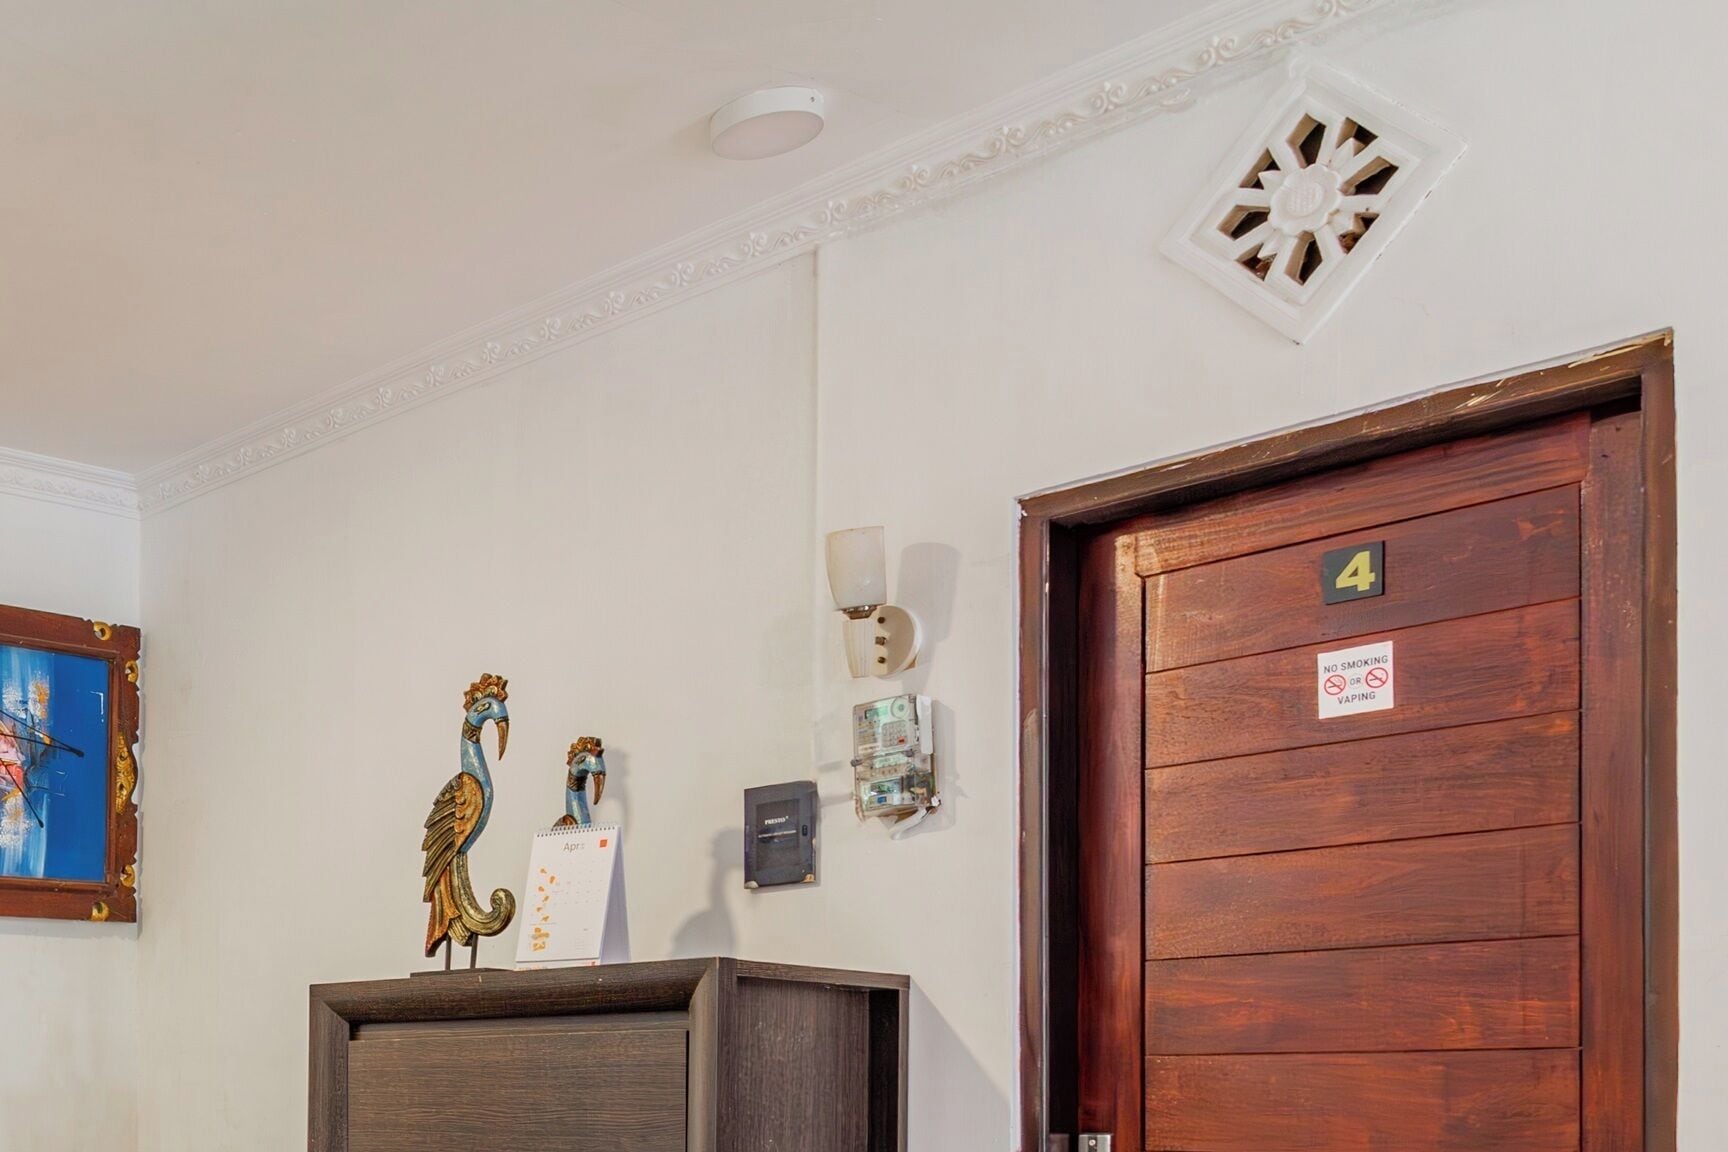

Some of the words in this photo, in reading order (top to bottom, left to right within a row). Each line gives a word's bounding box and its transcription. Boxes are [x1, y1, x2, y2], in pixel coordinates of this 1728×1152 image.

[1335, 550, 1376, 592] 4
[1323, 664, 1338, 674] NO
[1340, 655, 1389, 671] SMOKING
[1349, 677, 1361, 686] OR
[1337, 691, 1376, 705] VAPING
